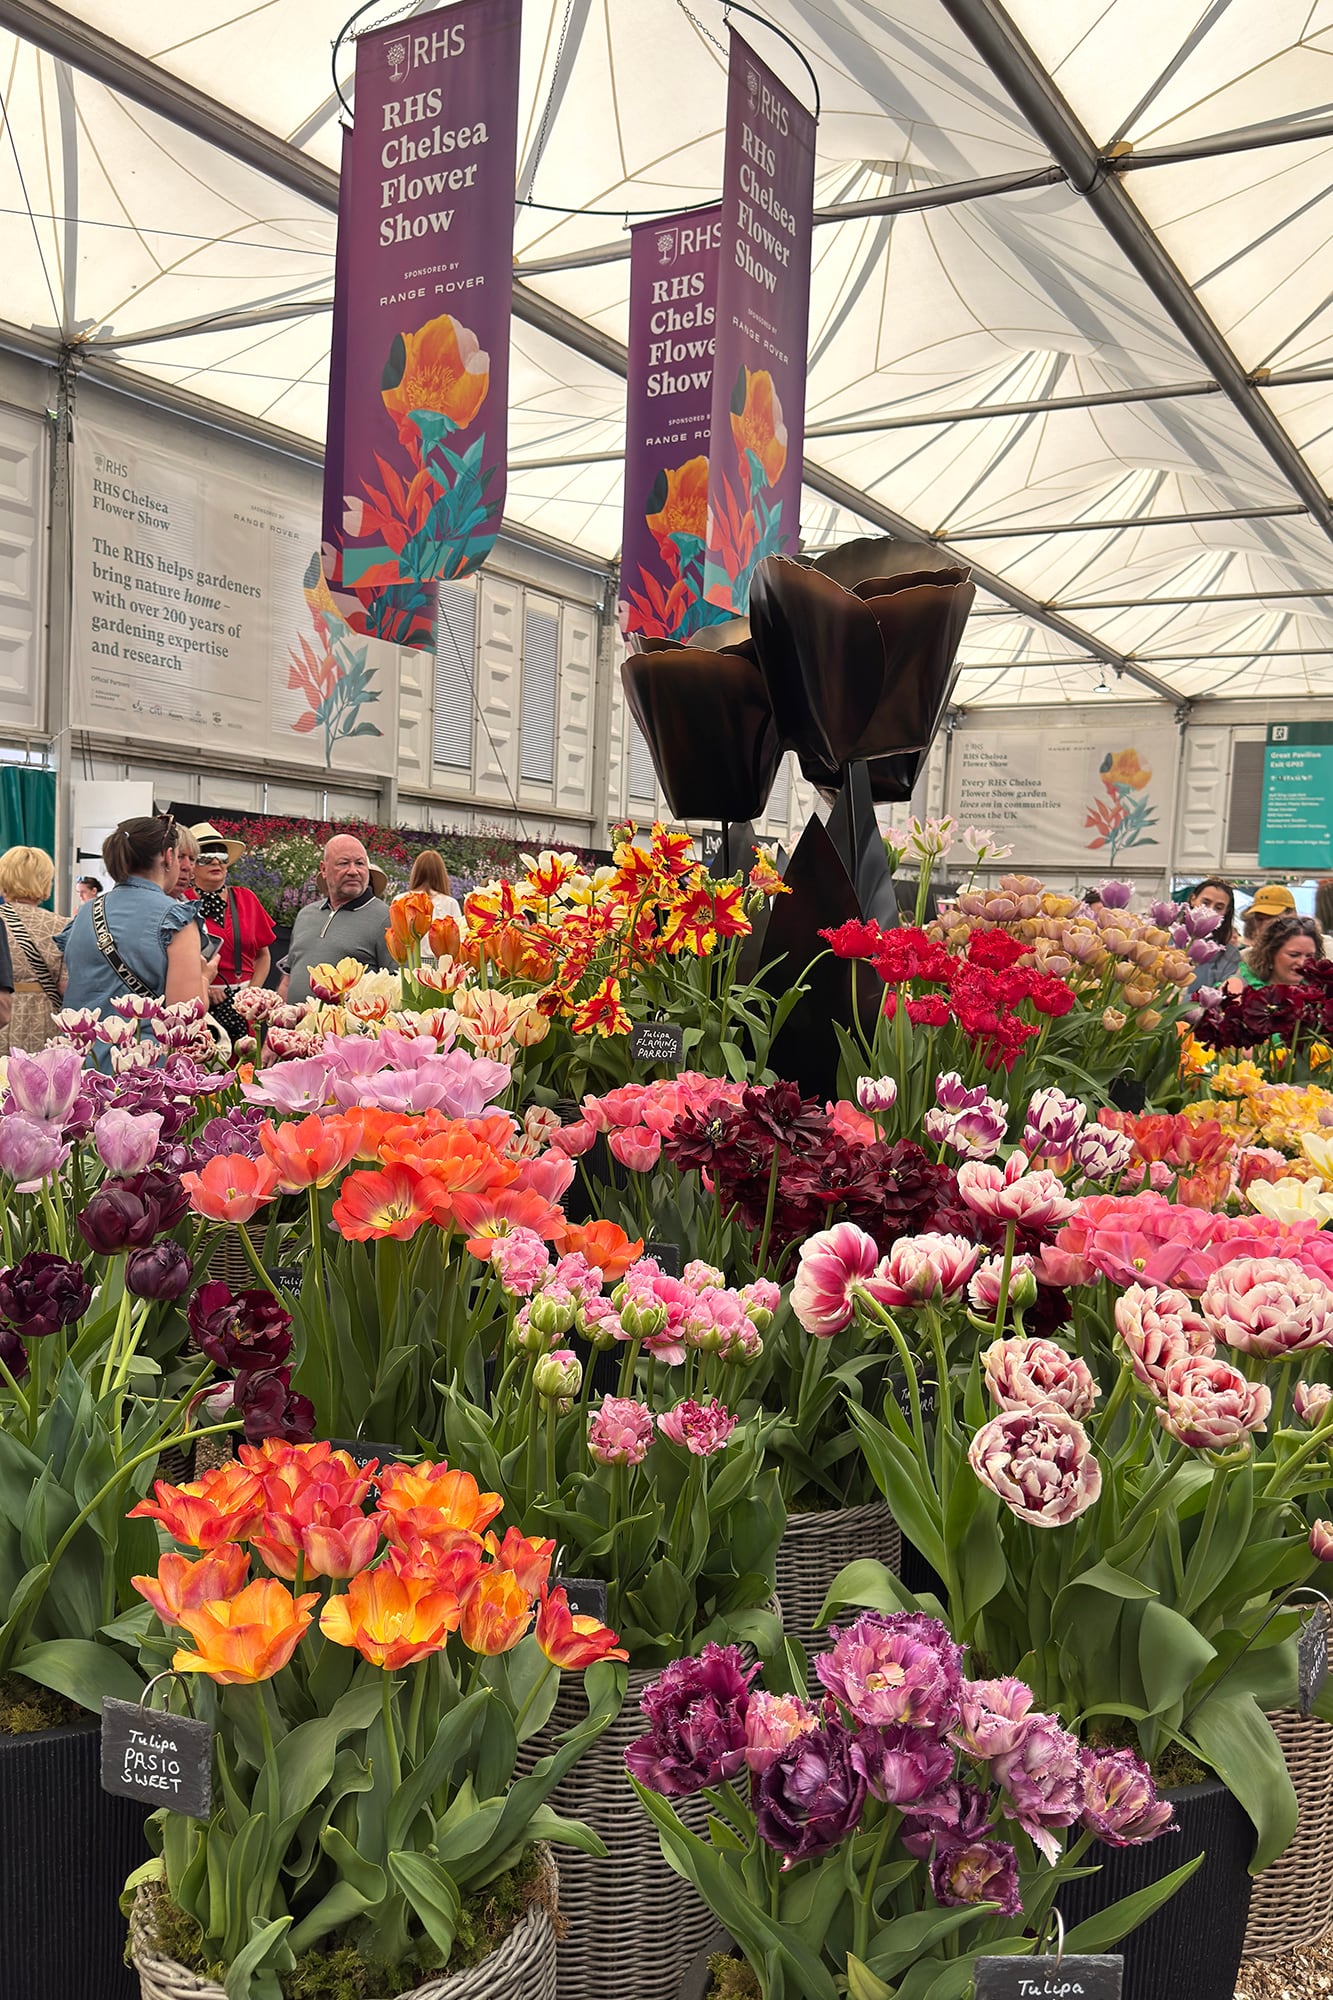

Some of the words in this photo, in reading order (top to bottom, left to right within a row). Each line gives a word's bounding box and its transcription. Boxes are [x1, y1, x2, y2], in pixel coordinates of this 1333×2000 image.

[413, 24, 466, 68] RHS
[381, 88, 443, 131] RHS
[761, 85, 789, 136] RHS
[381, 121, 489, 168] Chelsea
[741, 122, 776, 177] RHS
[380, 164, 478, 208] Flower
[740, 164, 796, 236] Chelsea
[379, 209, 455, 246] Show
[680, 222, 721, 255] RHS
[737, 200, 790, 267] Flower
[404, 264, 447, 279] SPONSORED
[449, 262, 459, 270] BY
[735, 239, 776, 293] Show
[380, 288, 426, 306] RANGE
[435, 276, 484, 294] ROVER
[651, 272, 705, 304] RHS
[650, 302, 716, 335] Chels
[648, 337, 716, 366] Flowe
[733, 316, 760, 343] RANGE
[763, 340, 788, 365] ROVER
[647, 370, 712, 398] Show
[668, 415, 705, 426] SPONSORED
[646, 433, 687, 446] RANGE
[106, 459, 128, 478] RHS
[93, 478, 120, 499] RHS
[122, 488, 168, 514] Chelsea
[93, 495, 135, 521] Flower
[137, 510, 170, 531] Show
[233, 513, 265, 529] RANGE
[270, 525, 300, 539] ROVER
[92, 537, 119, 559] The
[123, 546, 154, 569] RHS
[157, 556, 194, 582] helps
[196, 571, 262, 599] gardeners
[92, 561, 132, 591] bring
[135, 578, 181, 600] nature
[184, 587, 222, 611] home
[92, 590, 126, 611] with
[130, 600, 160, 619] over
[163, 606, 187, 626] 200
[189, 615, 225, 635] years
[228, 623, 243, 639] of
[91, 615, 165, 647] gardening
[168, 633, 229, 659] expertise
[91, 640, 120, 658] and
[123, 646, 183, 672] research
[961, 779, 986, 788] Every
[988, 779, 1007, 787] RHS
[1009, 778, 1042, 787] Chelsea
[961, 789, 990, 798] Flower
[992, 789, 1014, 798] Show
[1016, 789, 1047, 798] garden
[959, 811, 986, 819] across
[988, 811, 1001, 819] the
[1003, 811, 1018, 819] UK
[960, 800, 980, 809] lives
[994, 800, 1002, 809] in
[1004, 800, 1061, 809] communities
[118, 963, 143, 991] LOLA
[636, 1038, 677, 1051] FLAMING
[643, 1029, 670, 1040] Tulipa
[638, 1047, 676, 1058] PARROT
[129, 1729, 177, 1753] Tulipa
[124, 1748, 180, 1775] PASIO
[121, 1768, 182, 1793] SWEET
[1018, 1978, 1085, 1997] Tulipa
